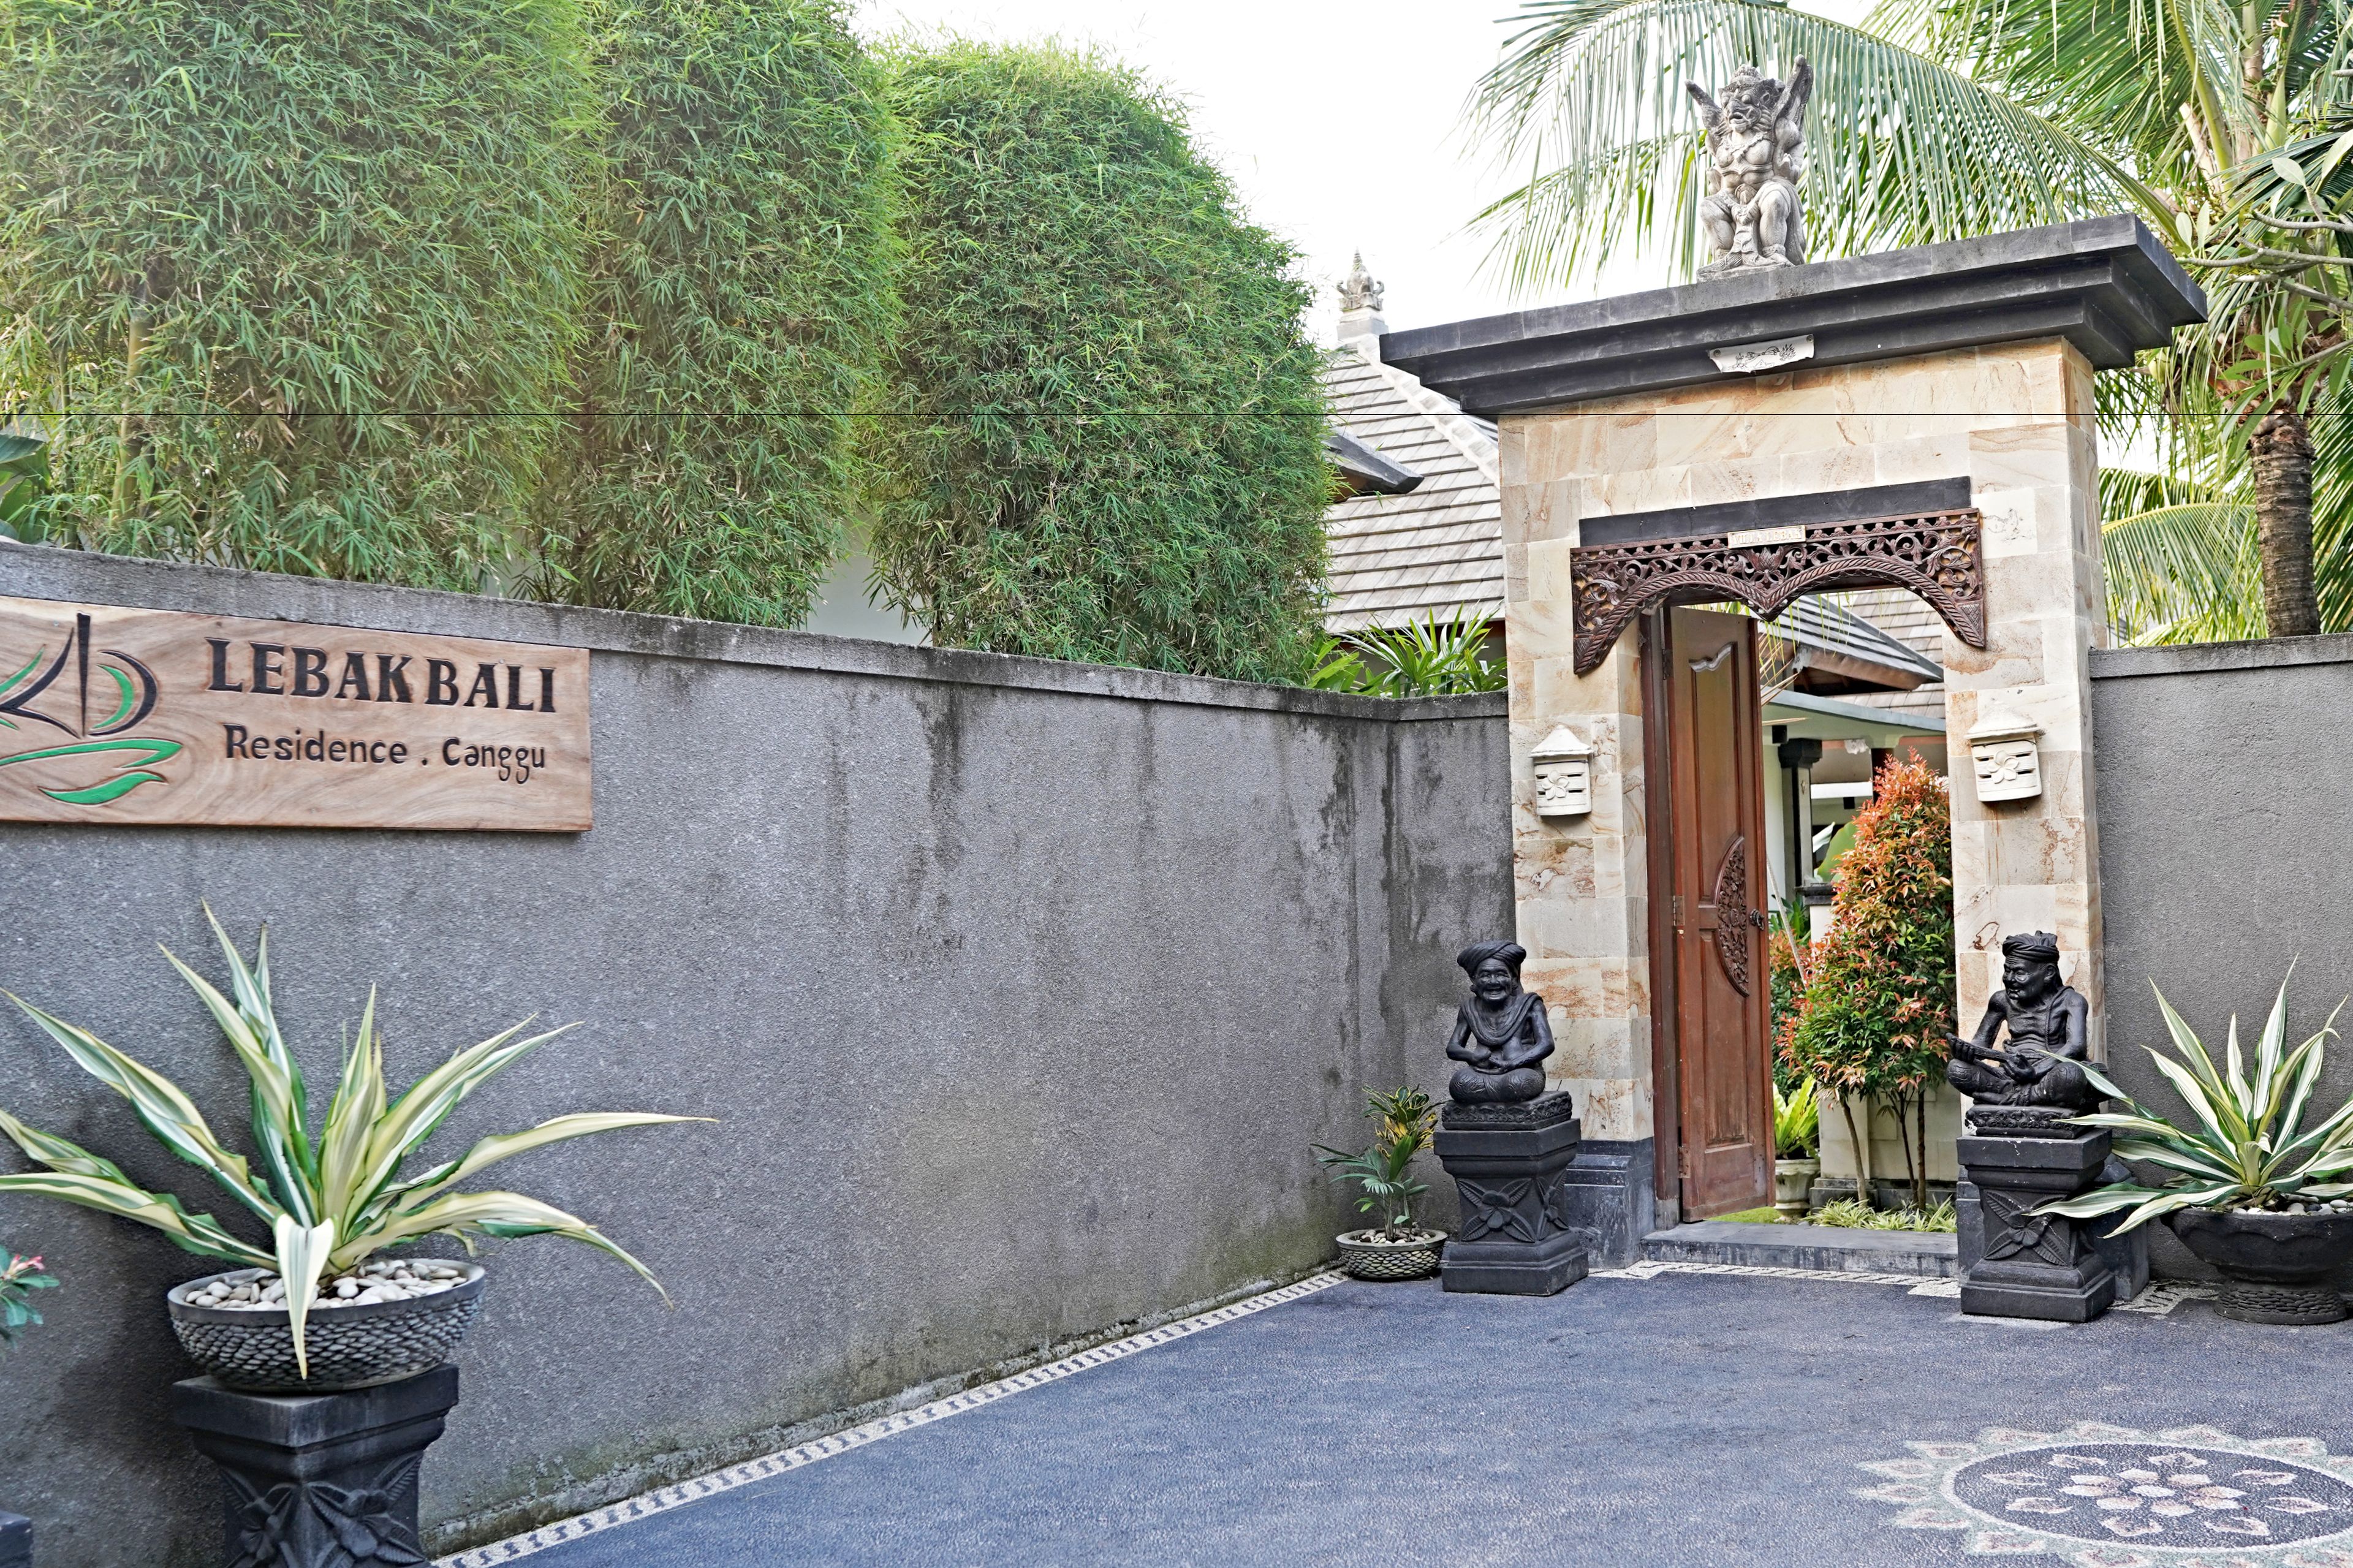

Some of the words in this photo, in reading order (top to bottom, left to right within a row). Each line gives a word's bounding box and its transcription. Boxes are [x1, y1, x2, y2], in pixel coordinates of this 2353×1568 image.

[1733, 532, 1764, 545] VILLA
[205, 637, 412, 703] LEBAK
[424, 657, 556, 713] BALI
[222, 722, 408, 765] Residence
[442, 737, 545, 784] Canggu
